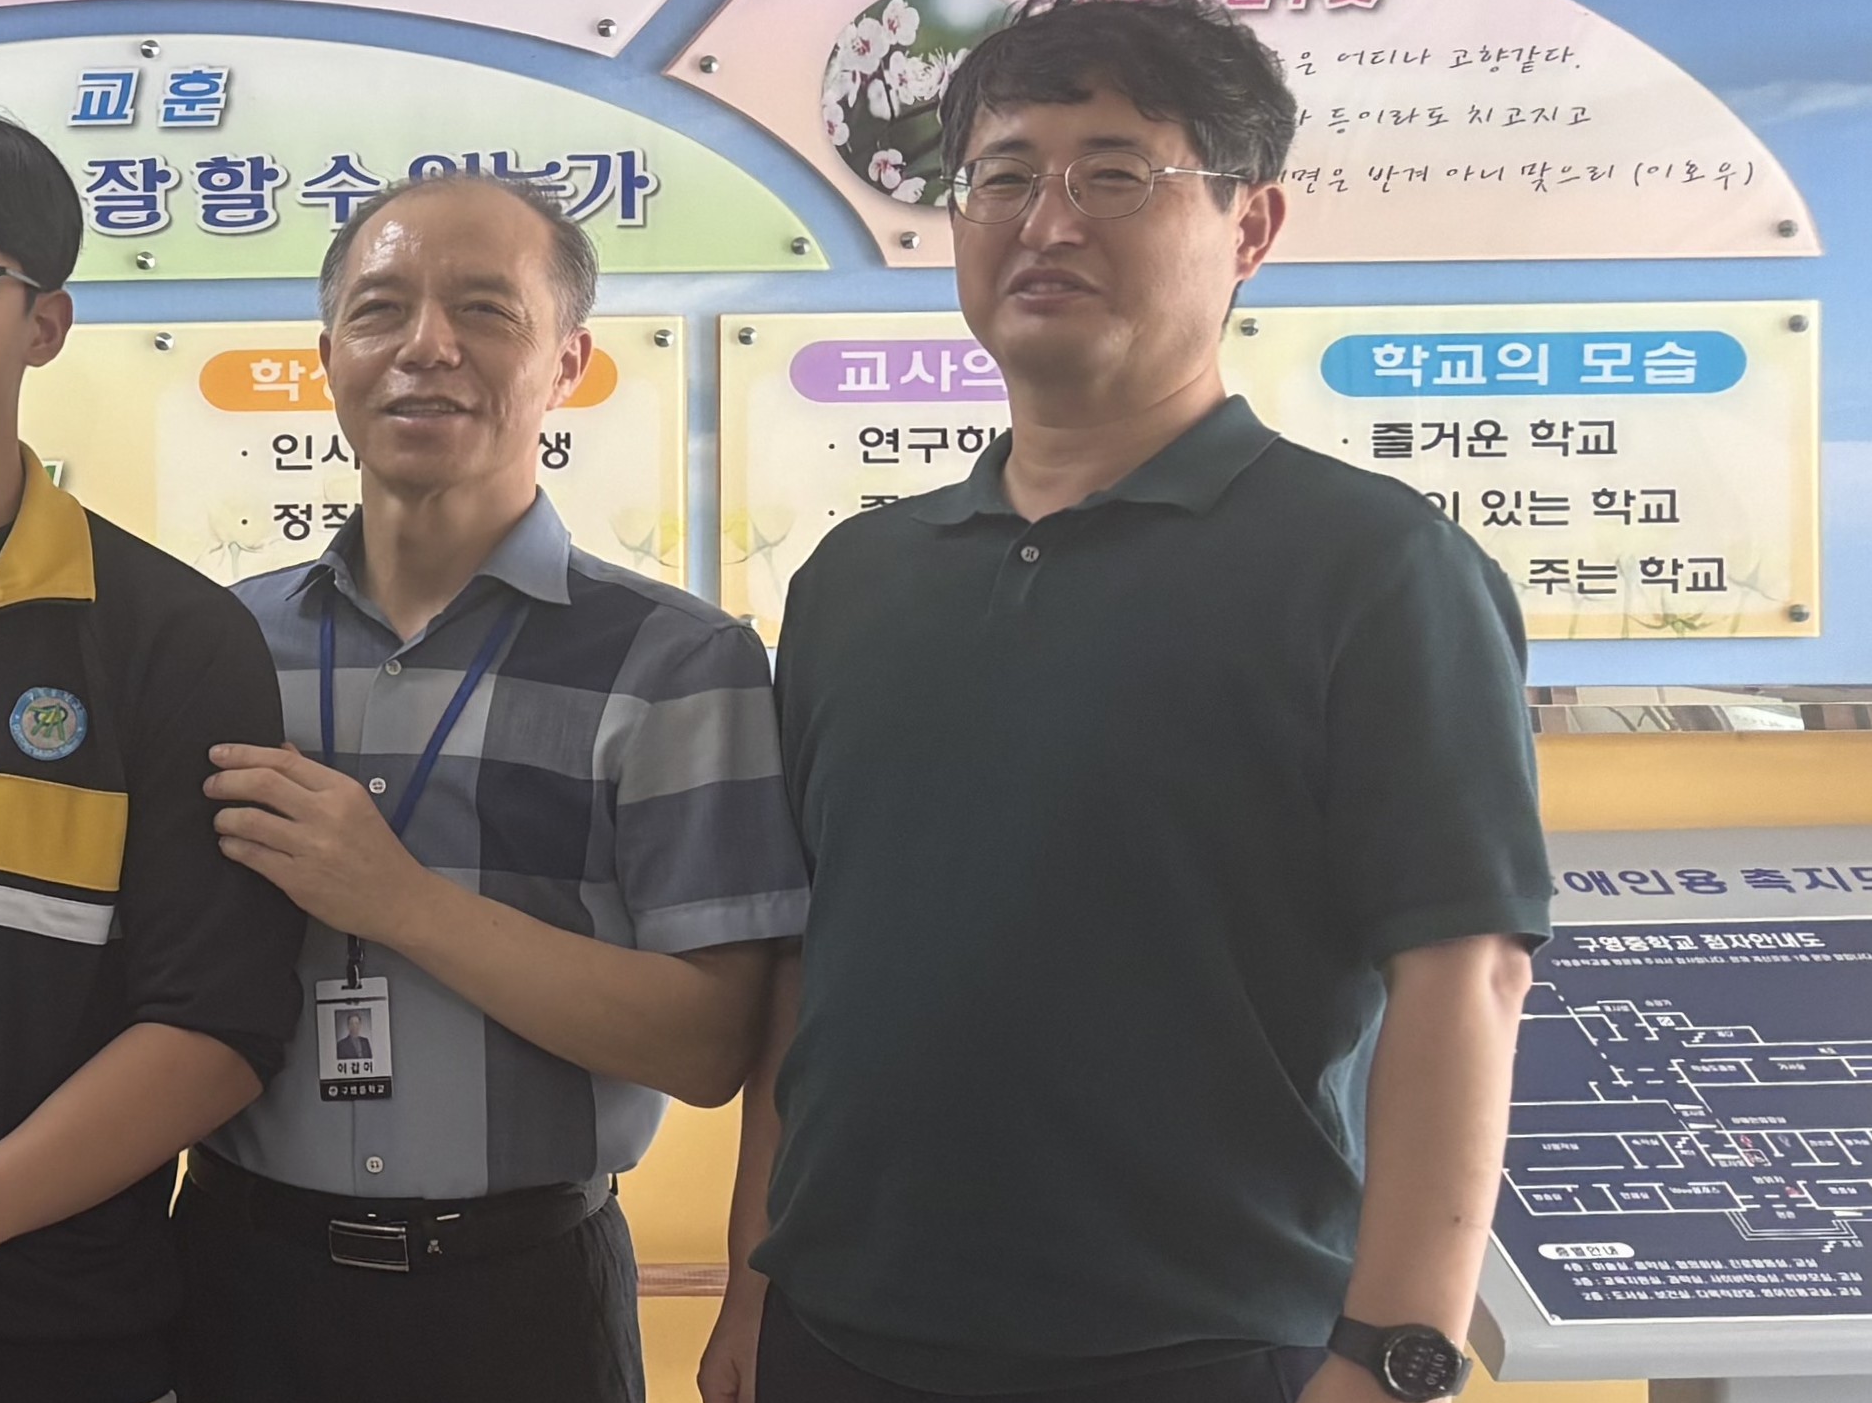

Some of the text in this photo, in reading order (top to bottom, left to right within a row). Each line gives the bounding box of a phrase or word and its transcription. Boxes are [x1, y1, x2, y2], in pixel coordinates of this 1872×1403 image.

[1326, 106, 1449, 134] 등이라도
[1446, 163, 1503, 183] 아니
[84, 157, 172, 233] 잘
[195, 155, 280, 231] 할
[301, 153, 385, 225] 수
[1372, 340, 1698, 387] 학교의 모습
[1371, 418, 1618, 459] 즐거운 학교
[1481, 489, 1570, 527] 있는
[1591, 487, 1680, 526] 학교
[1529, 556, 1728, 595] 주는 학교
[1551, 868, 1729, 896] 애인용
[1573, 931, 1827, 953] 구영중학교 점자안내도
